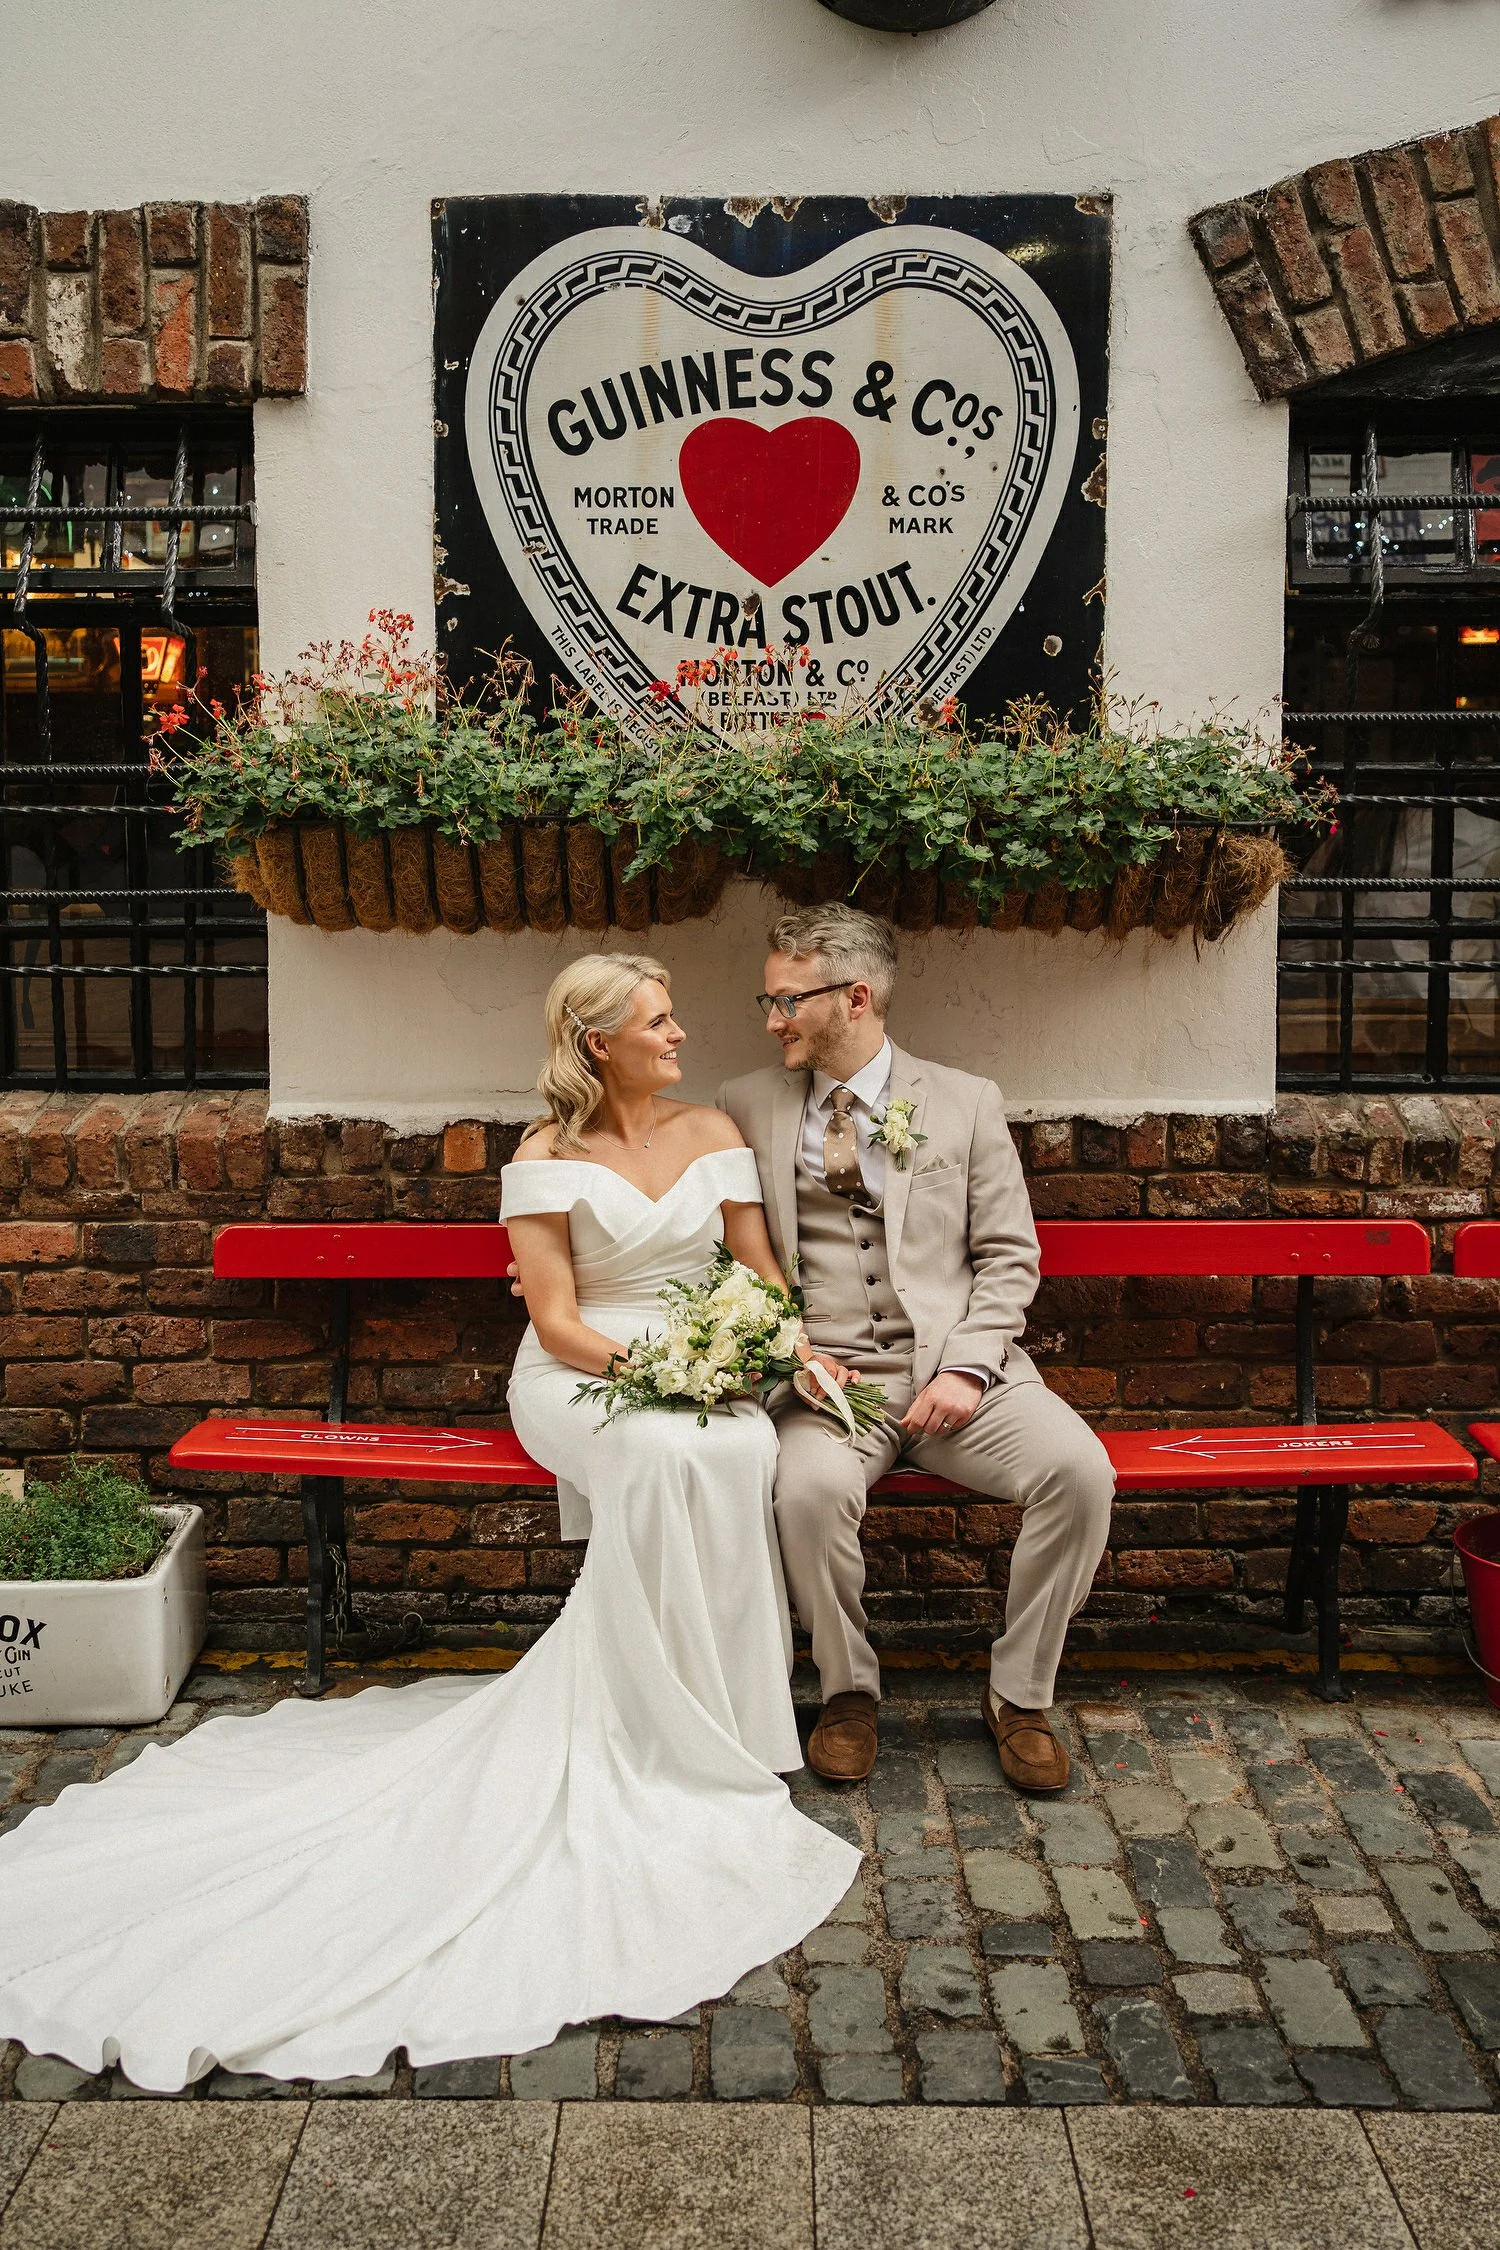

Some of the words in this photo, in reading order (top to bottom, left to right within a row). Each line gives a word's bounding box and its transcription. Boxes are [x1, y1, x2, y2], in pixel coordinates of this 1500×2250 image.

[548, 348, 835, 456] GUINNESS
[853, 360, 897, 423] &
[574, 487, 674, 508] MORTON
[882, 485, 900, 507] &
[908, 481, 965, 506] CO'S
[587, 518, 658, 535] TRADE
[889, 517, 954, 534] MARK
[614, 562, 767, 649] EXTRA
[782, 560, 936, 645] STOUT.
[970, 626, 996, 652] LTD.
[551, 625, 576, 658] THIS
[574, 659, 609, 699] LABEL
[606, 699, 623, 714] IS
[805, 659, 825, 687] &
[300, 1433, 380, 1441] CLOWNS
[1278, 1440, 1353, 1448] JOKERS
